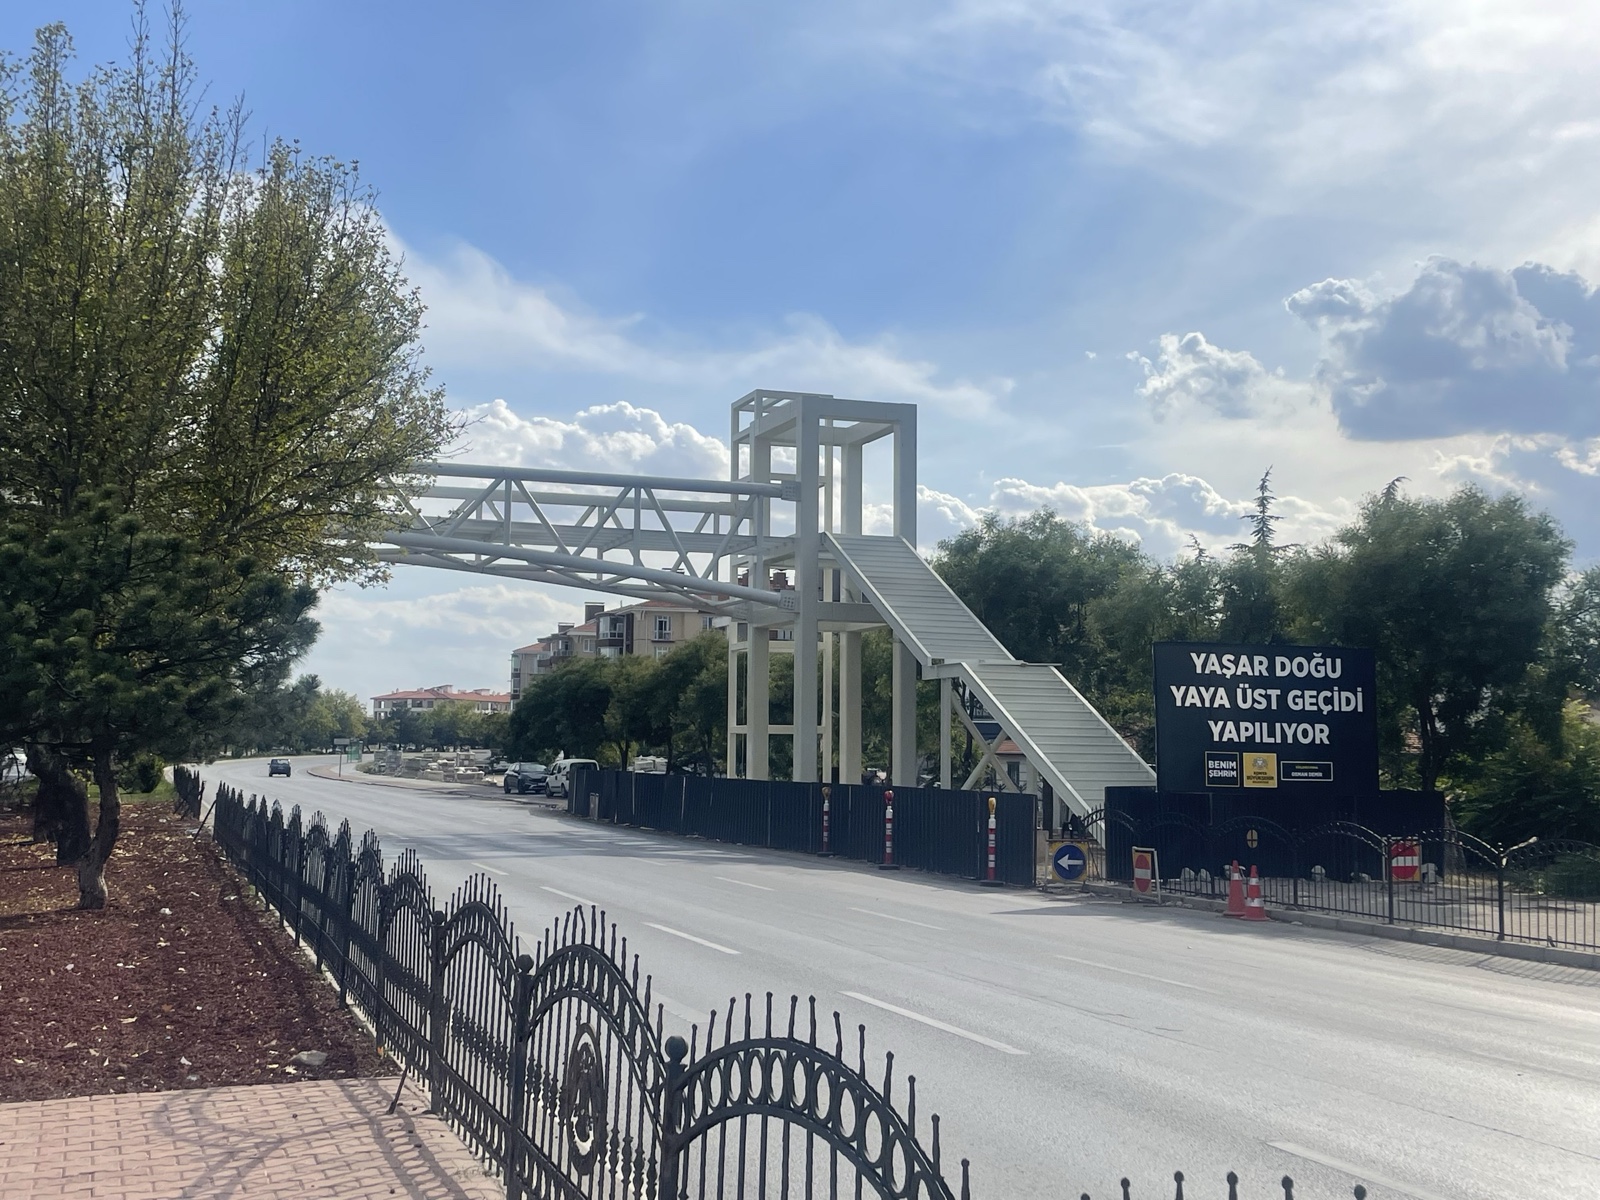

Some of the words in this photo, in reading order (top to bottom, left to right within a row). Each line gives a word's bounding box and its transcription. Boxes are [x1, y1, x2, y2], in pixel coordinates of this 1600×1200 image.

[1190, 652, 1269, 679] YAŞAR
[1275, 652, 1342, 679] DOĞU
[1170, 685, 1231, 709] YAYA
[1236, 683, 1281, 710] ÜST
[1287, 686, 1364, 715] GEÇİDİ
[1207, 720, 1330, 744] YAPILIYOR
[1208, 760, 1237, 769] BENİM
[1208, 769, 1237, 778] ŞEHRİM
